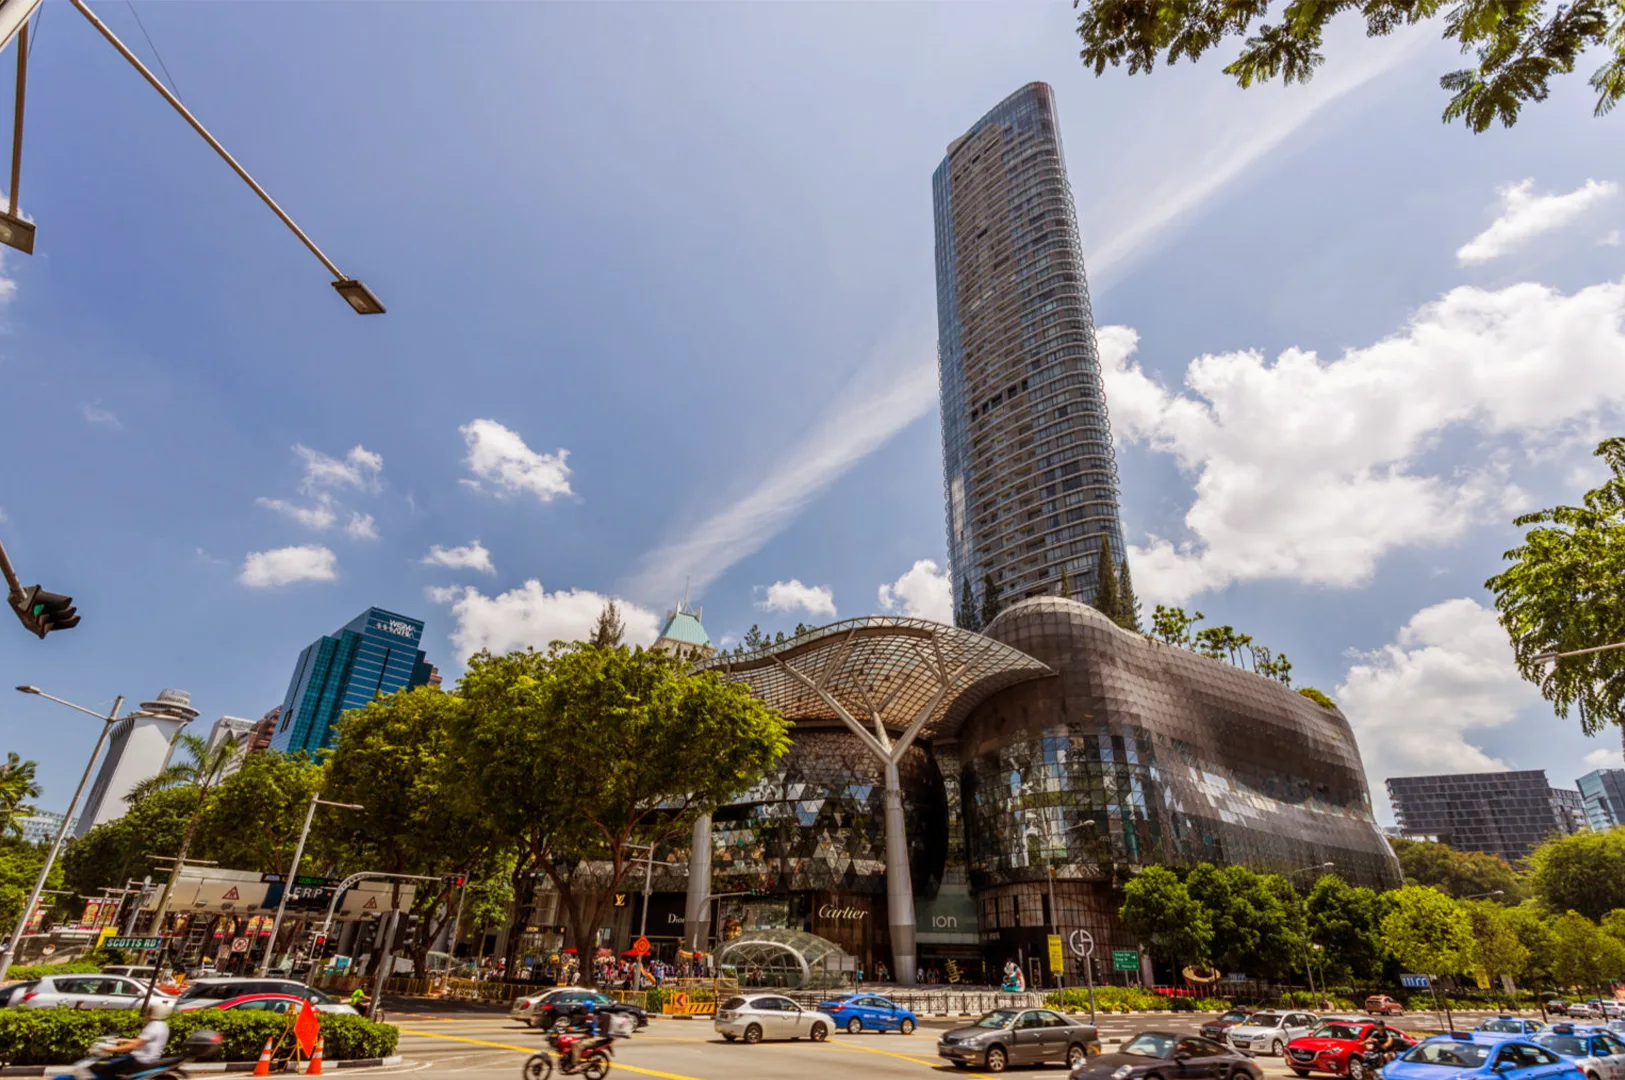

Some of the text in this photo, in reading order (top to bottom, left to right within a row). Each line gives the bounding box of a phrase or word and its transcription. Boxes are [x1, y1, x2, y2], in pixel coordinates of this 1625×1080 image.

[294, 887, 323, 899] ERP
[818, 903, 868, 920] Cartier
[667, 914, 685, 923] Dior
[106, 938, 157, 948] SCOTTS RD
